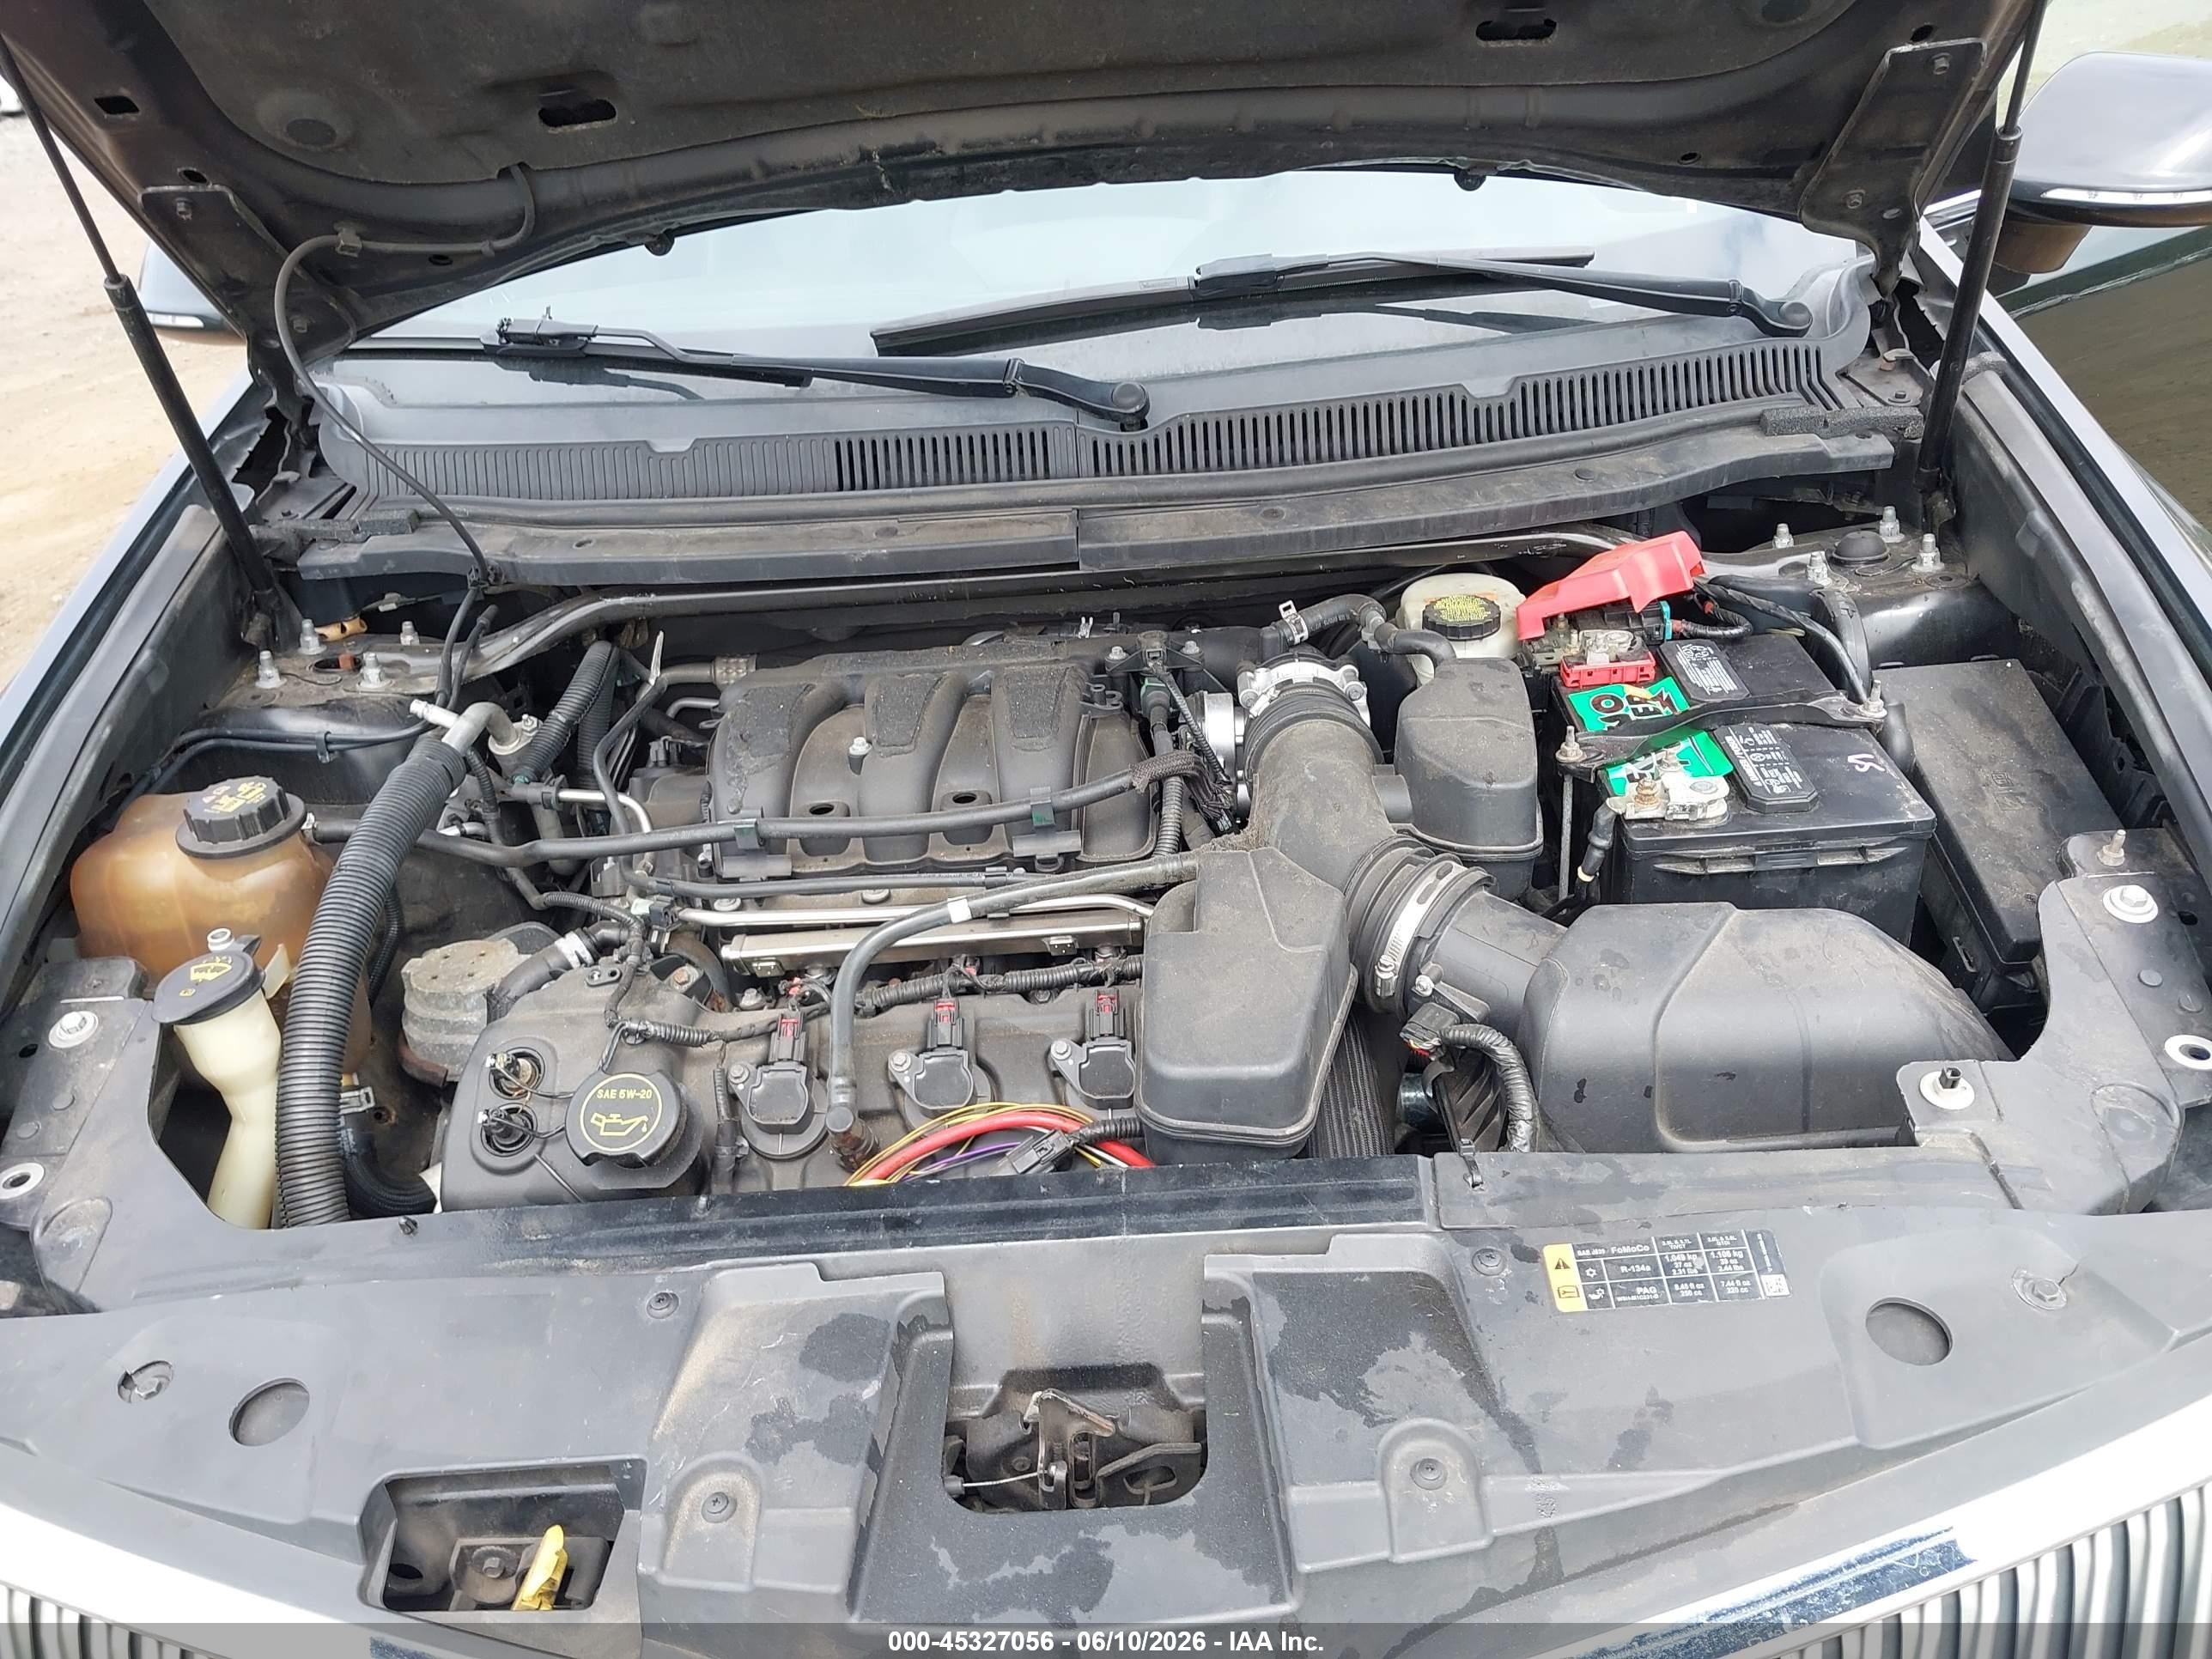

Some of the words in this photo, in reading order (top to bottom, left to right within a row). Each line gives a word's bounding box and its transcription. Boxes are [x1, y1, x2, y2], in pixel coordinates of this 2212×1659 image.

[597, 1088, 617, 1099] SAE
[1610, 1244, 1650, 1254] FoMoCo
[1732, 1249, 1744, 1259] kg
[1620, 1264, 1651, 1273] R-134a
[1636, 1285, 1657, 1295] PAG
